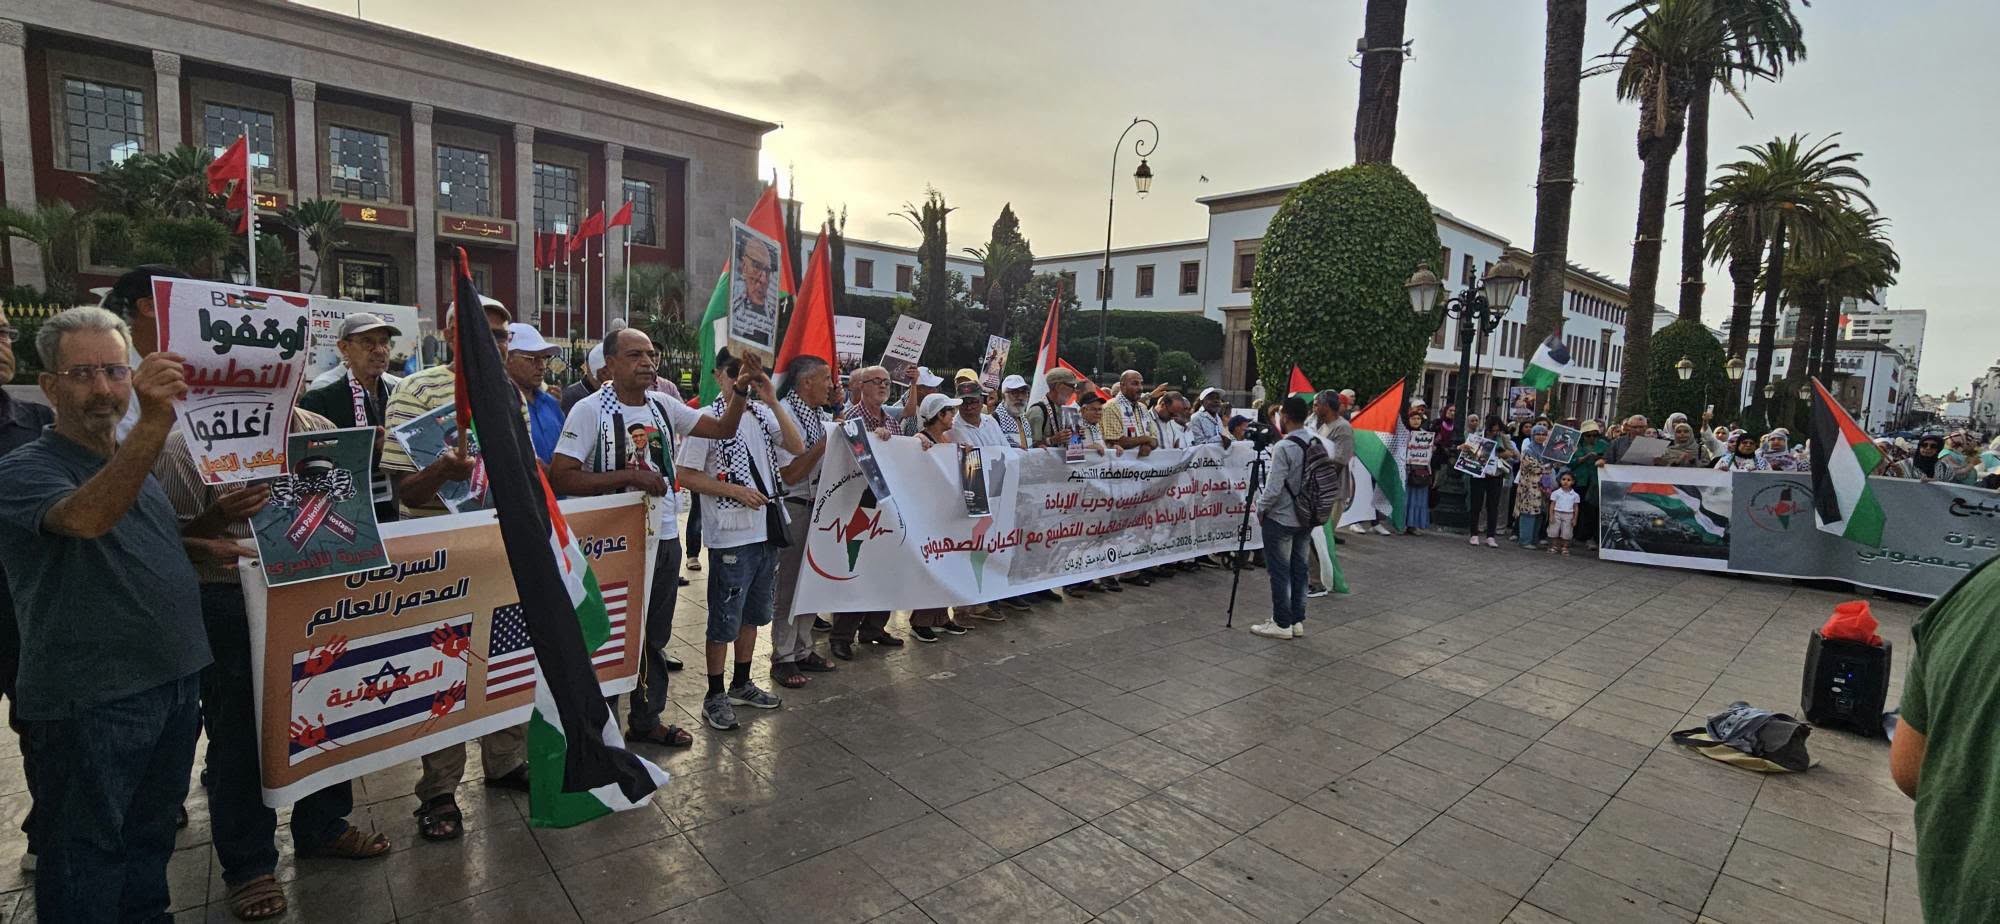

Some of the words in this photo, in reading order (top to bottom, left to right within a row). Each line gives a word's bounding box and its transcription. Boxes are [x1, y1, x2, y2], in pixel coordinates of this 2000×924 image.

[199, 308, 308, 360] أوقفوا
[185, 402, 274, 452] أغلقوا
[1167, 477, 1199, 499] الأسرى
[1202, 478, 1231, 497] إعدام
[1046, 493, 1079, 514] الإبادة
[1081, 496, 1114, 513] وحرب
[1189, 502, 1223, 520] الاتصال
[1155, 507, 1187, 526] بالرباط
[291, 525, 307, 542] Free
[988, 528, 1023, 553] الكيان
[1025, 532, 1043, 550] مع
[1045, 521, 1084, 548] التطبيع
[583, 536, 627, 560] عدوة
[920, 534, 984, 564] الصهيوني
[393, 577, 470, 616] المدمر
[306, 591, 392, 638] للعالم
[326, 660, 443, 707] الصهيونية
